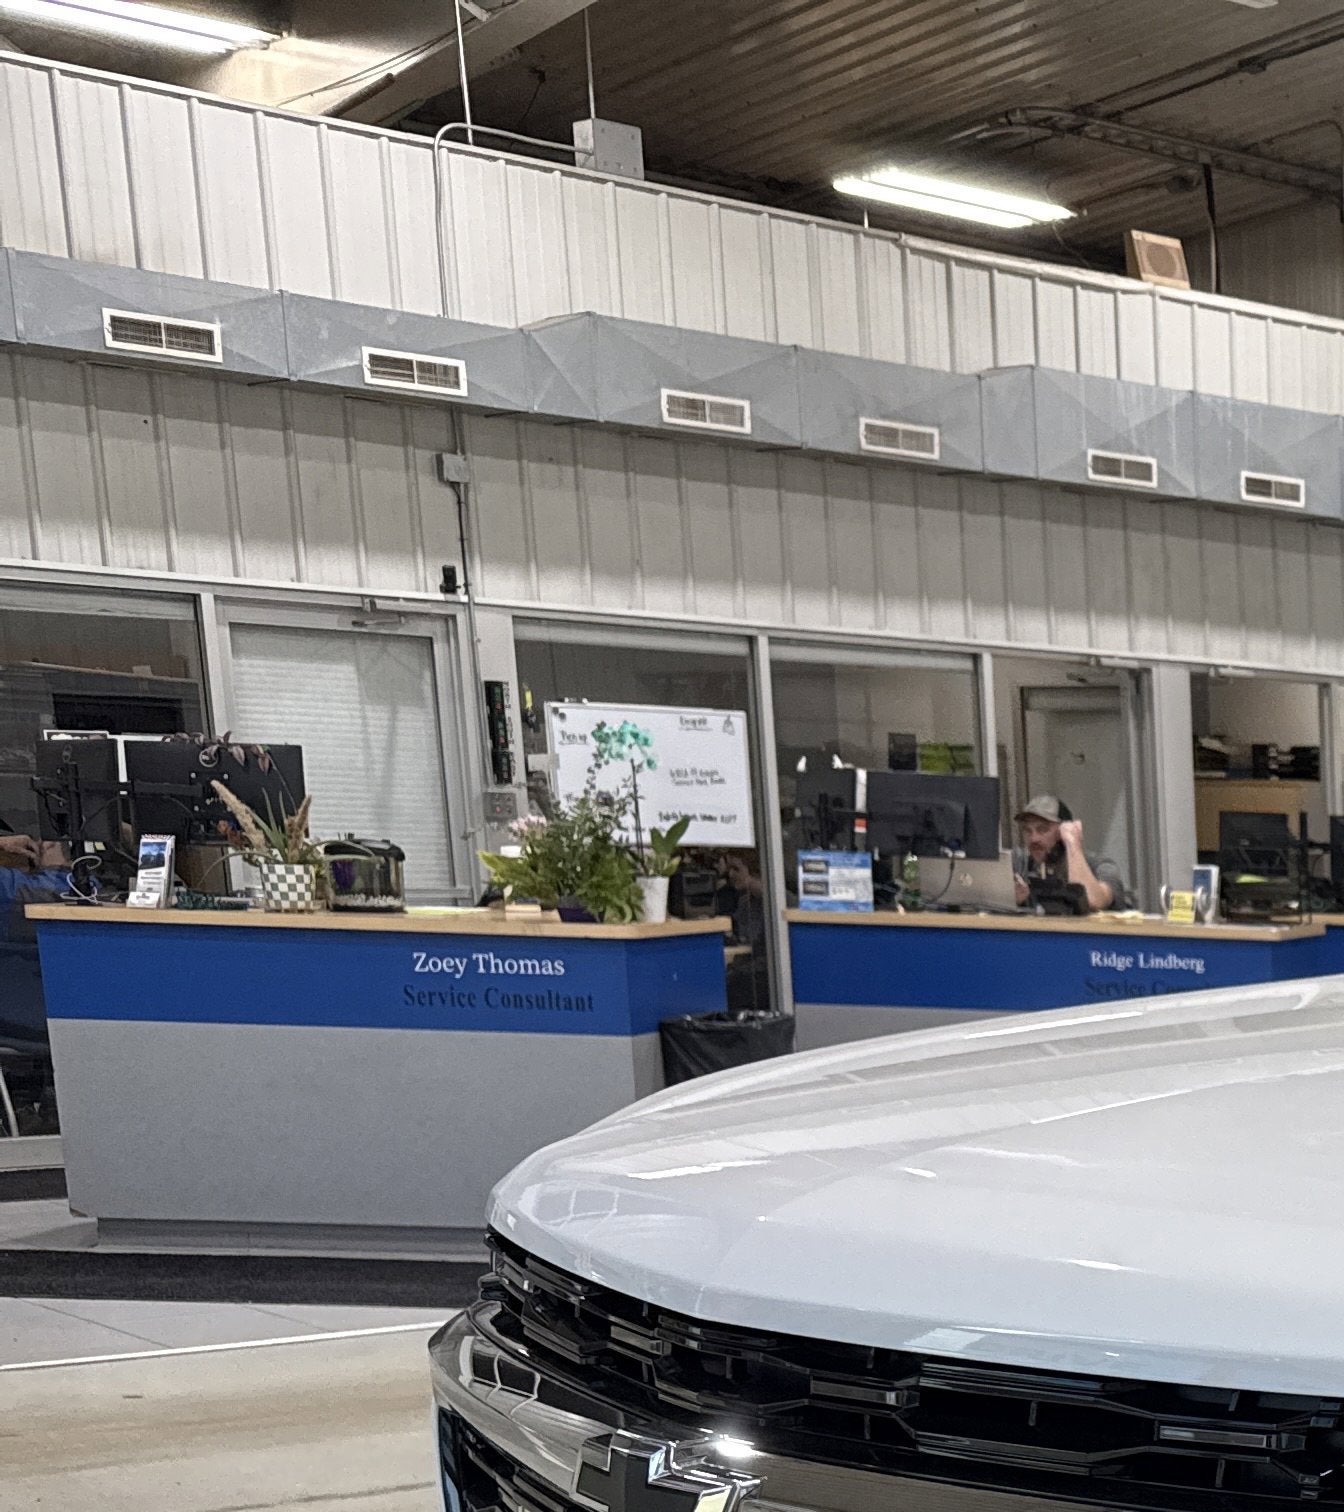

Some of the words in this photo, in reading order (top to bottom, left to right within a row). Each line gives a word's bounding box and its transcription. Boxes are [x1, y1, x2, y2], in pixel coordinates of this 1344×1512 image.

[412, 951, 467, 979] Zoey
[472, 952, 566, 976] Thomas
[1090, 950, 1134, 972] Ridge
[1138, 952, 1206, 974] Lindberg
[403, 984, 477, 1009] Service
[484, 986, 595, 1013] Consultant
